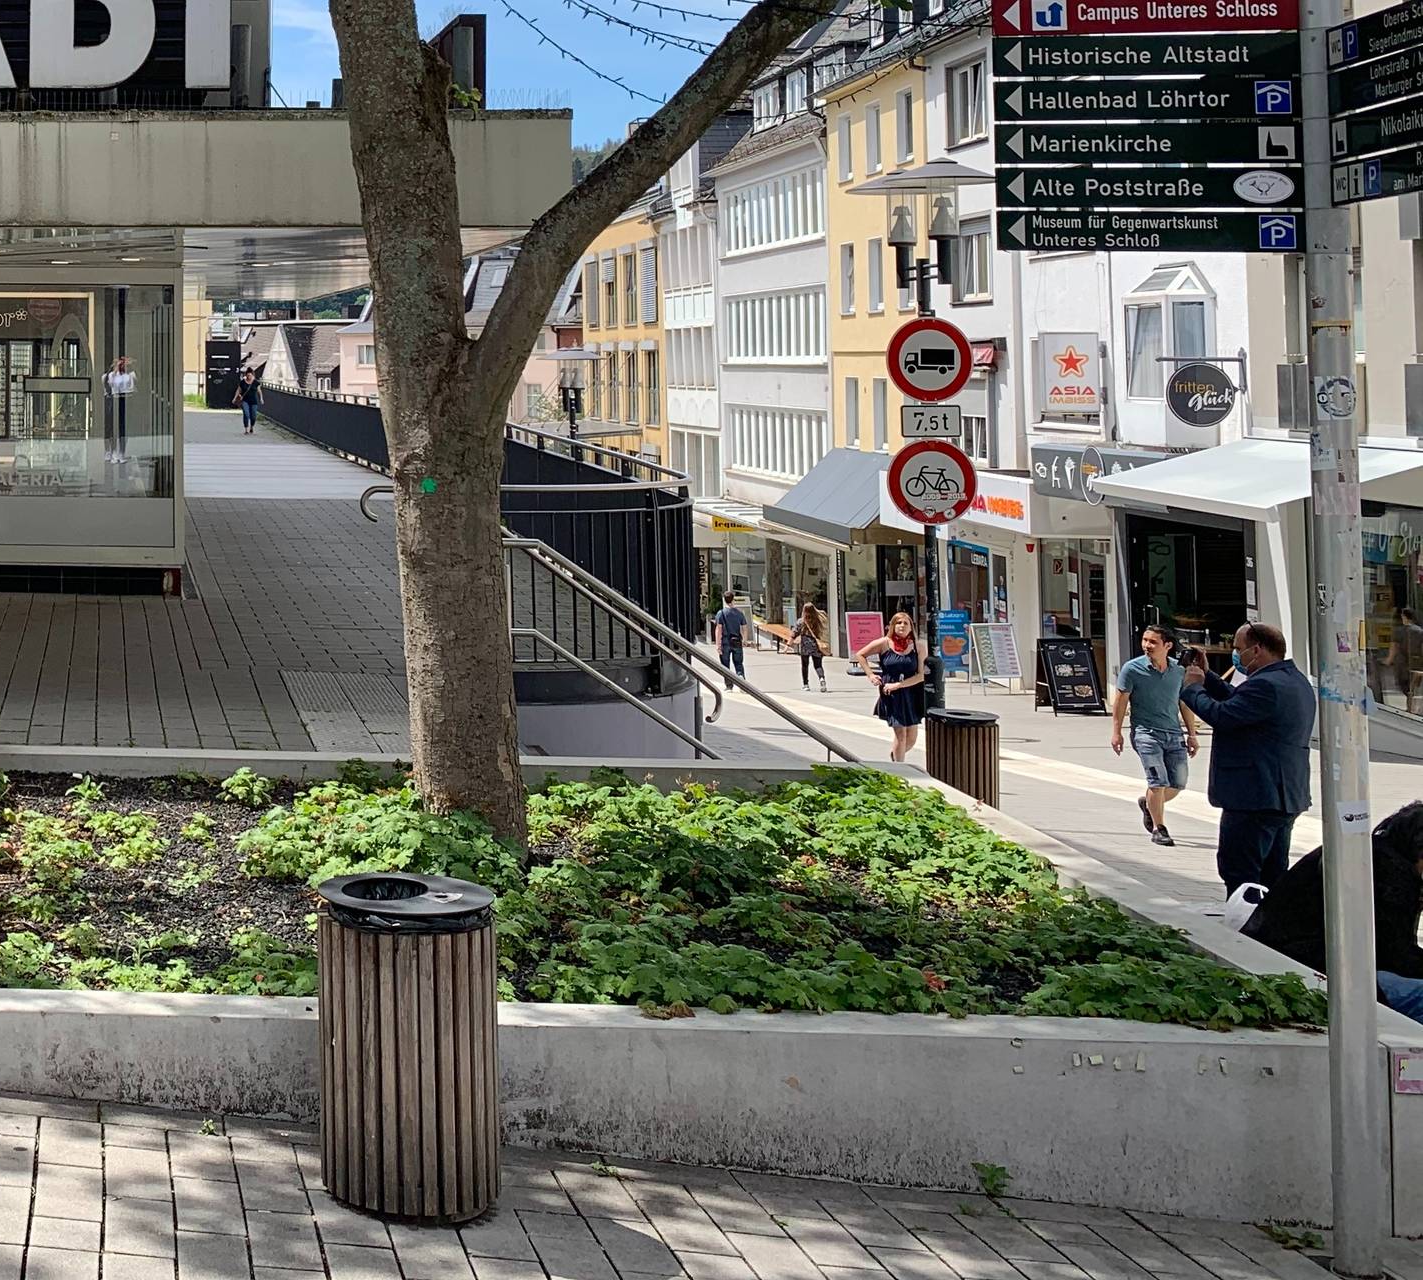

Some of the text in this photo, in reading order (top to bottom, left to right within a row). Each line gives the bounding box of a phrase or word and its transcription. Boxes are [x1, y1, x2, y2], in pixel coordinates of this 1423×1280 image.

[1077, 0, 1278, 24] Campus Unteres Schloss
[1384, 10, 1409, 28] Oberes
[1028, 46, 1250, 65] Historische Altstadt
[1370, 56, 1410, 80] Löhrstraße
[1375, 78, 1412, 98] Marburger
[1029, 90, 1230, 109] Hallenbad Löhrtor
[1030, 134, 1172, 152] Marienkirche
[1032, 178, 1204, 196] Alte Poststraße
[1393, 179, 1405, 190] am
[1032, 215, 1218, 232] Museum für Gegenwartskunst
[1032, 233, 1160, 247] Unteres Schloß
[1049, 386, 1096, 396] ASIA
[1174, 380, 1215, 393] fritten
